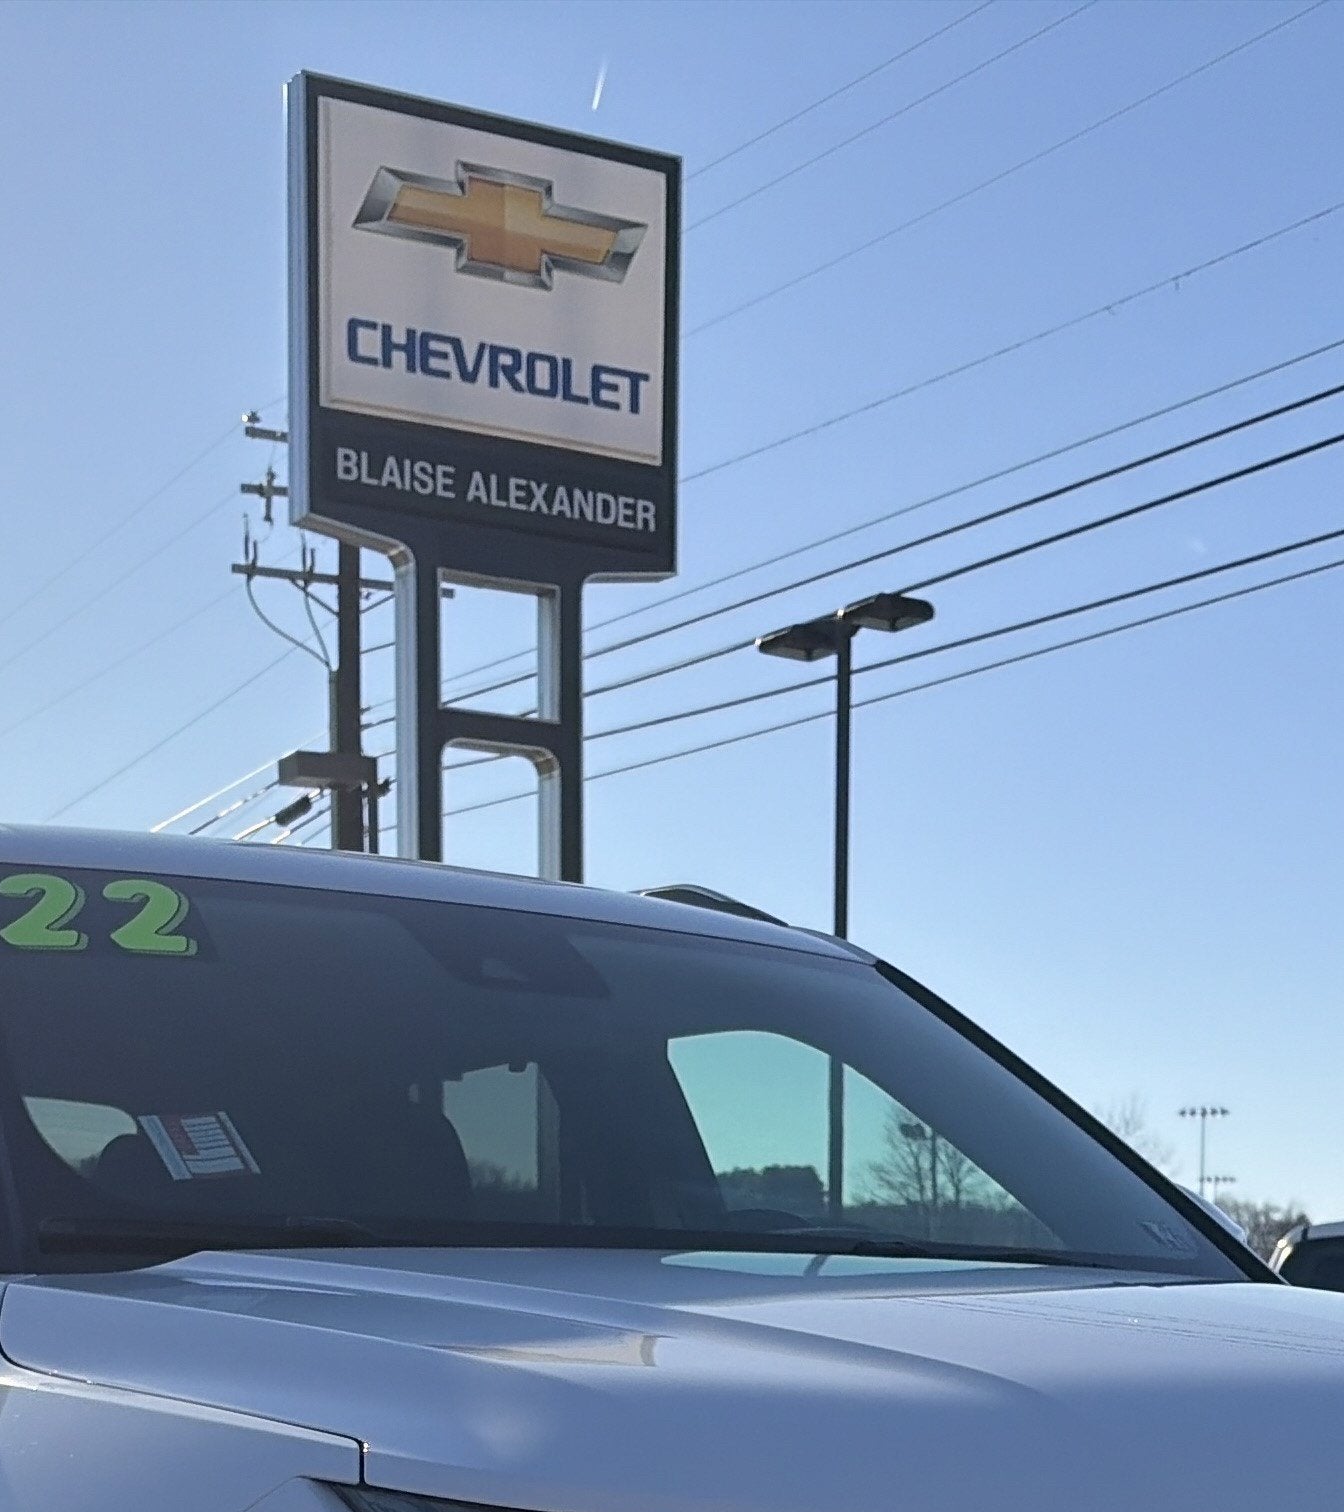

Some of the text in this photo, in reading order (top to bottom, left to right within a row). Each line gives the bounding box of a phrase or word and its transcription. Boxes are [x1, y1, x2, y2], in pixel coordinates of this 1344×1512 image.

[346, 316, 650, 415] CHEVROLET
[335, 446, 656, 532] BLAISE ALEXANDER
